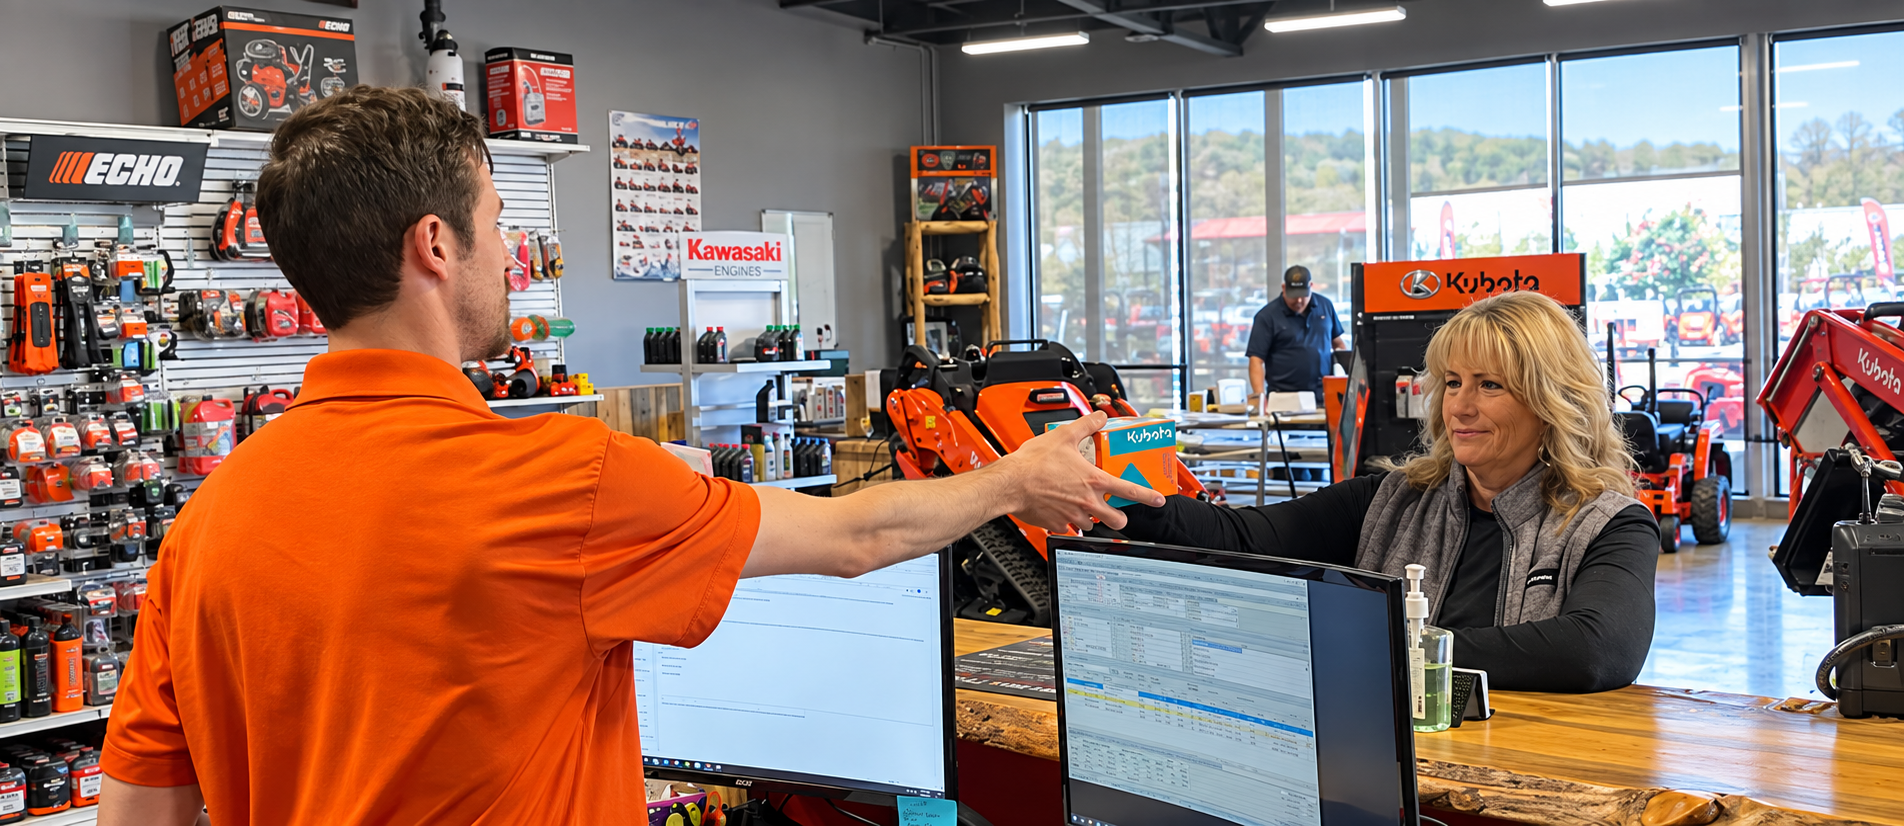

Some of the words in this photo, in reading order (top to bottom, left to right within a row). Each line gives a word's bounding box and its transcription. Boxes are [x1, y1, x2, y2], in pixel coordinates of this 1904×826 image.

[83, 152, 184, 187] ECHO
[687, 238, 782, 262] Kawasaki
[714, 265, 762, 277] ENGINES
[1446, 269, 1540, 294] Kubota
[1857, 347, 1902, 396] Kubota
[1127, 426, 1173, 444] Kubota
